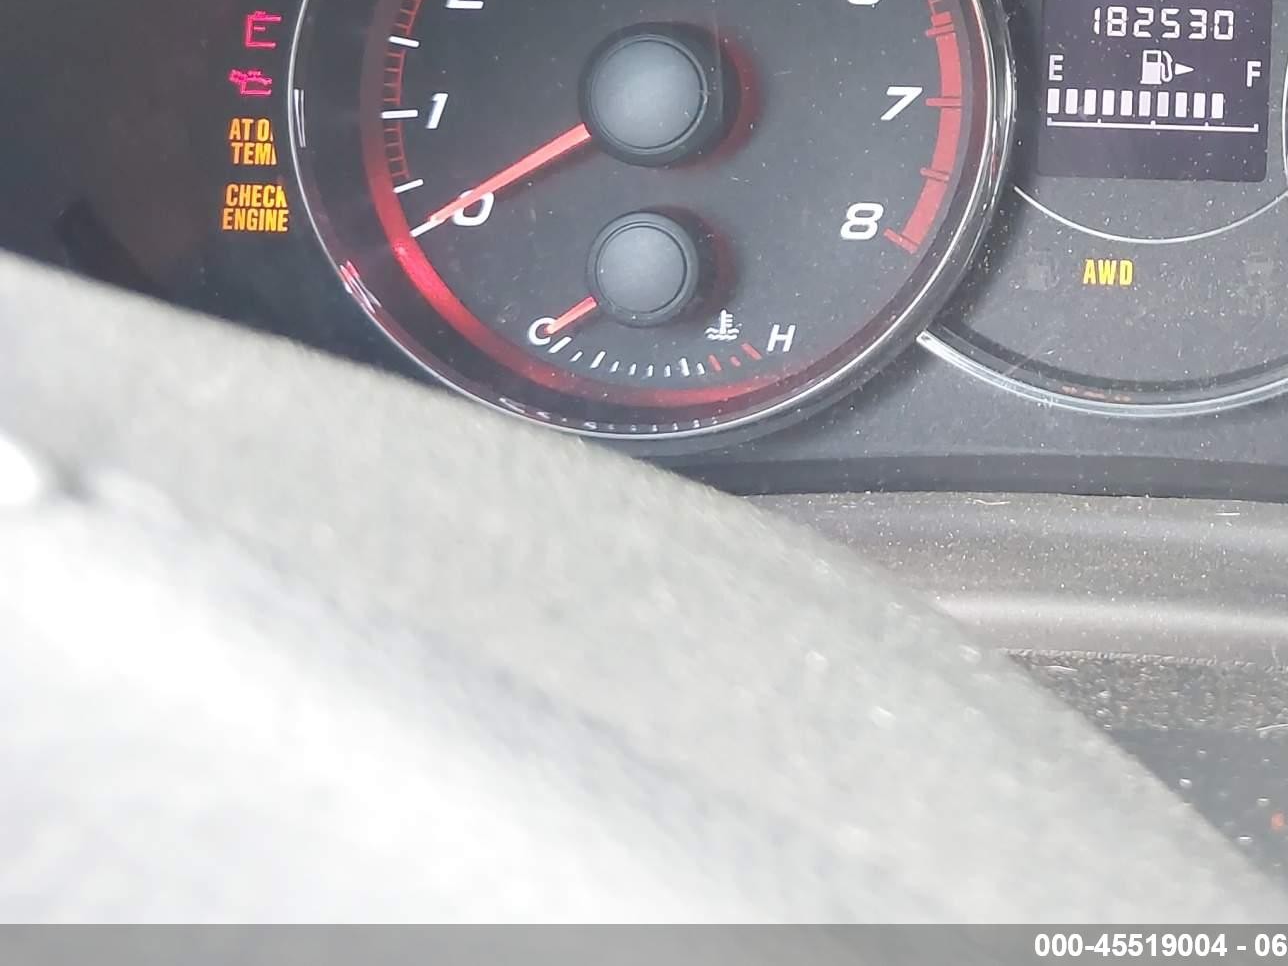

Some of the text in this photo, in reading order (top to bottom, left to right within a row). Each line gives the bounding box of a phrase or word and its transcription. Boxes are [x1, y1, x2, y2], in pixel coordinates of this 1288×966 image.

[1094, 7, 1233, 39] 182530
[1049, 55, 1063, 80] E
[1247, 61, 1261, 87] F
[427, 93, 448, 128] 1
[881, 87, 922, 120] 7
[230, 119, 253, 140] AT
[223, 208, 288, 231] ENGINE
[453, 190, 494, 226] 0
[841, 203, 883, 239] 8
[1083, 260, 1132, 285] AWD
[529, 317, 556, 346] C
[767, 325, 795, 351] H
